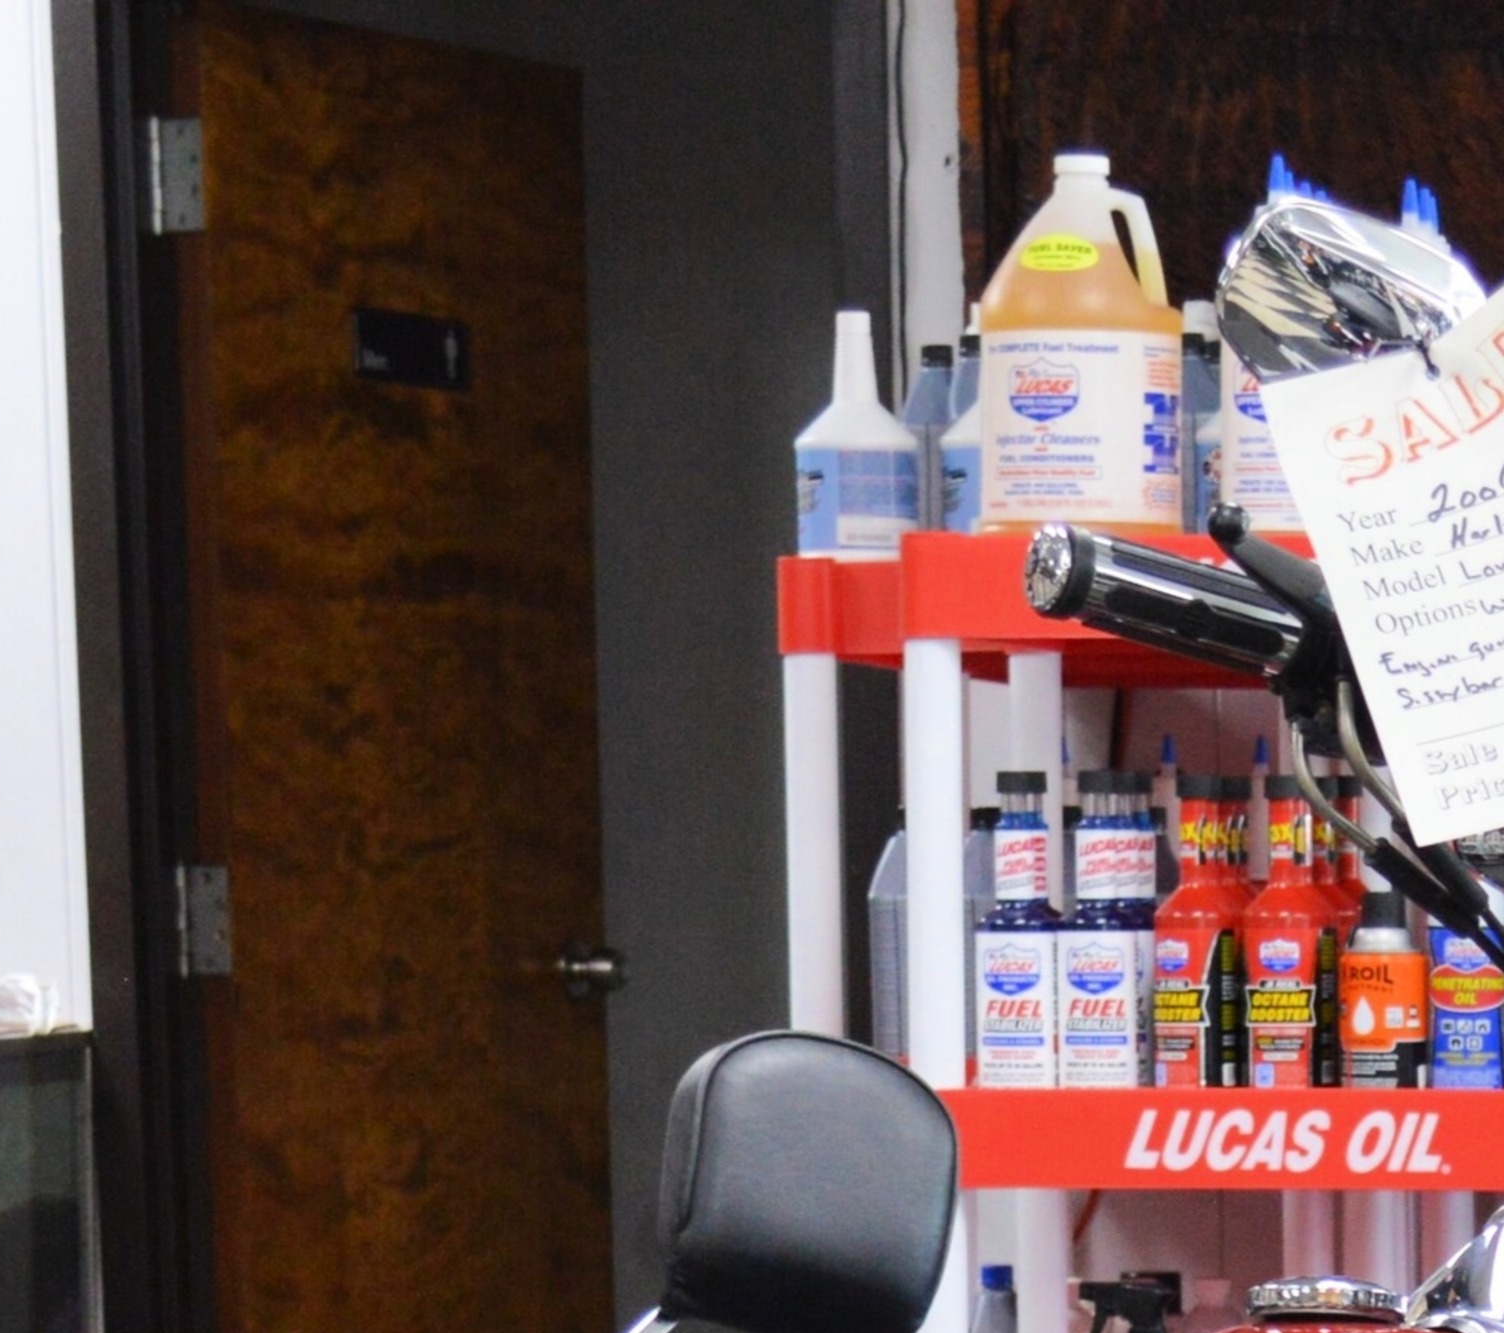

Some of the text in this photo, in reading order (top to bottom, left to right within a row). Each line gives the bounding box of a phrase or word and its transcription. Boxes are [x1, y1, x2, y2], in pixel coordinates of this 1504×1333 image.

[1015, 379, 1073, 394] LUCAS
[1040, 431, 1100, 445] Cleaners
[1337, 509, 1396, 533] Year
[1350, 538, 1425, 567] Make
[1362, 565, 1447, 601] Model
[1374, 599, 1477, 637] Options
[1424, 743, 1498, 775] Sale
[989, 960, 1035, 973] LUCAS
[1074, 959, 1119, 972] LUCAS
[1344, 964, 1394, 985] ROIL
[1069, 999, 1126, 1017] FUEL
[1253, 992, 1309, 1006] OCTANE
[1453, 993, 1477, 1005] OIL
[986, 1000, 1042, 1018] FUEL
[1250, 1007, 1310, 1021] BOOSTER
[1123, 1109, 1444, 1174] LUCAS OIL
